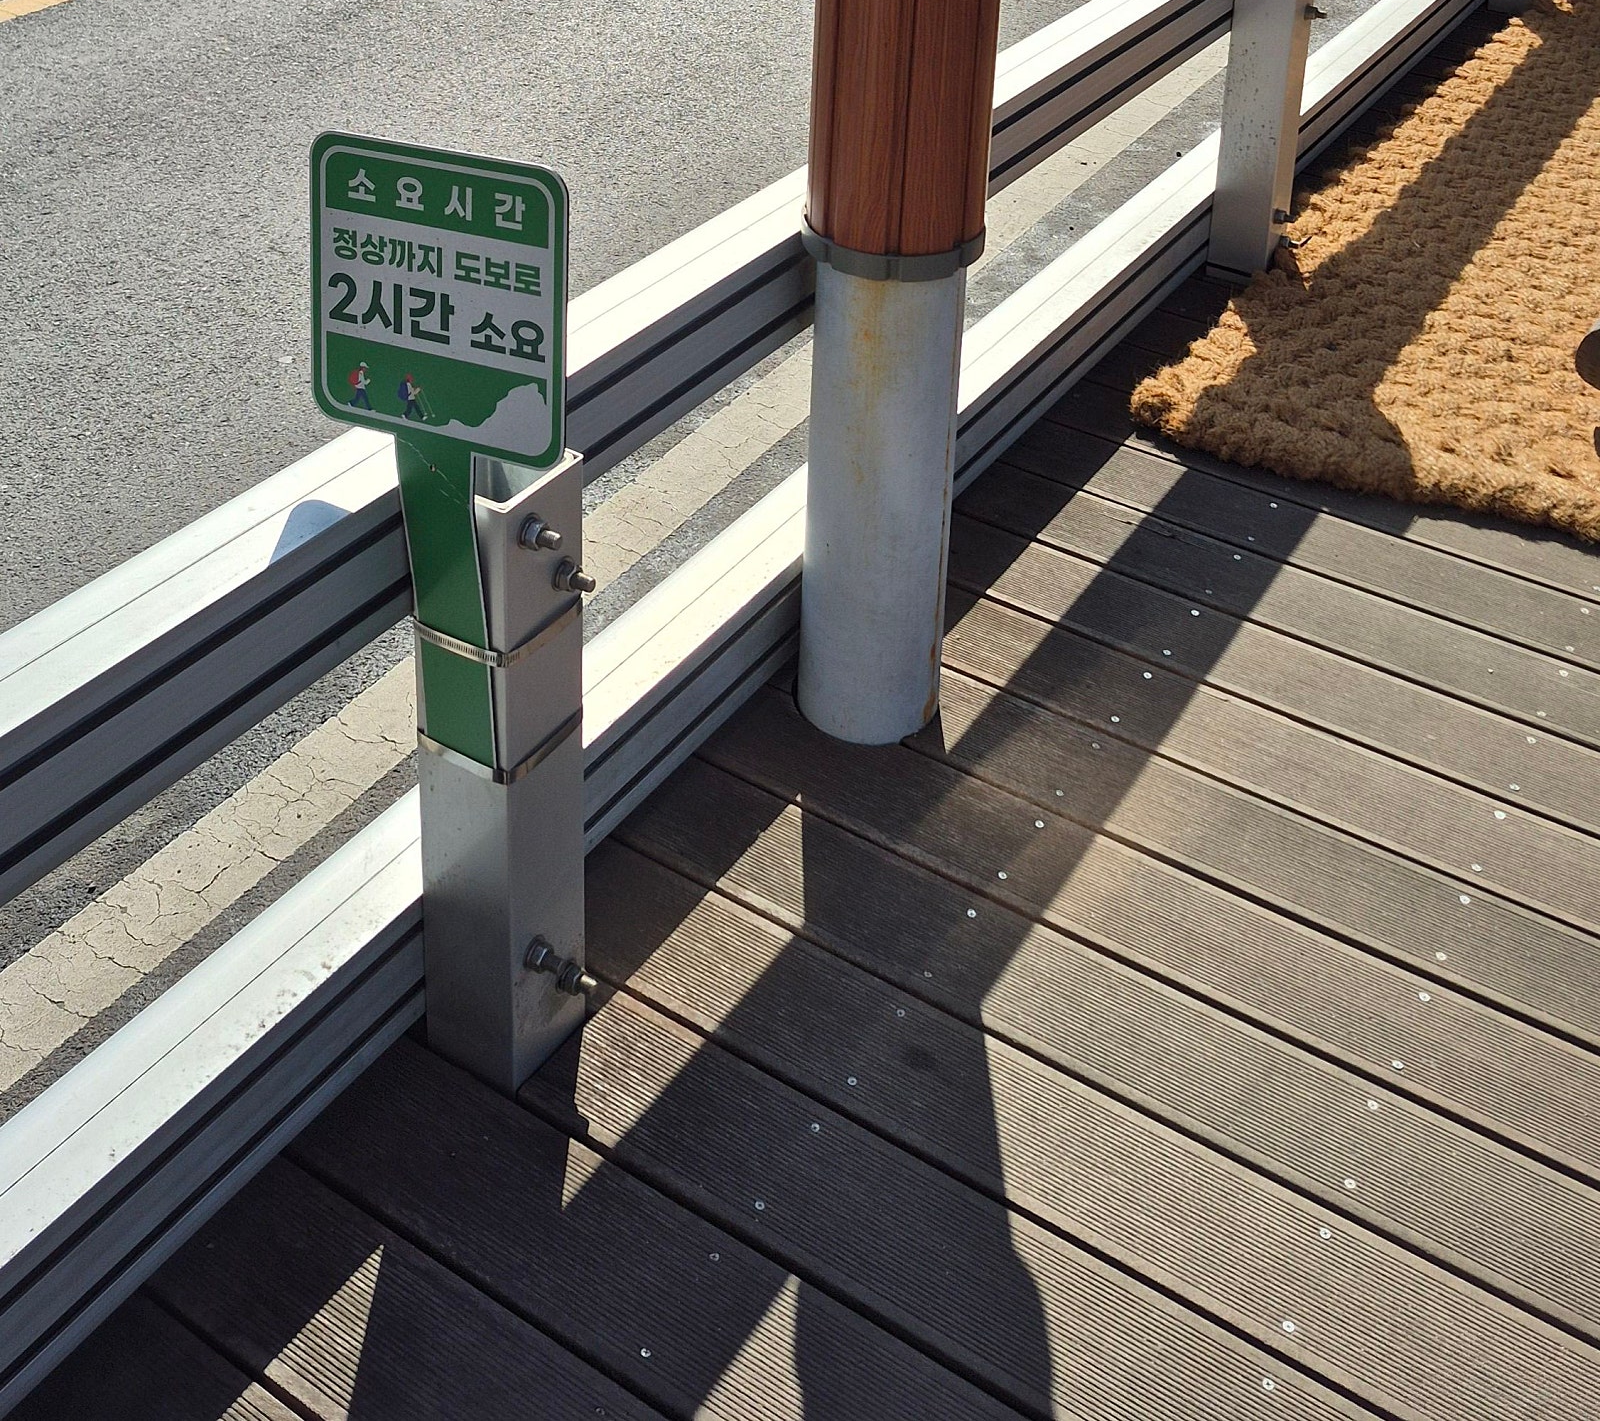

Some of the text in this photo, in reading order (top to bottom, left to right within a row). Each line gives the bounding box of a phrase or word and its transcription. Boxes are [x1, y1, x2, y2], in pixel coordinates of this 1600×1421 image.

[332, 226, 542, 298] 정상까지 도보로
[327, 272, 546, 363] 2시간 소요
